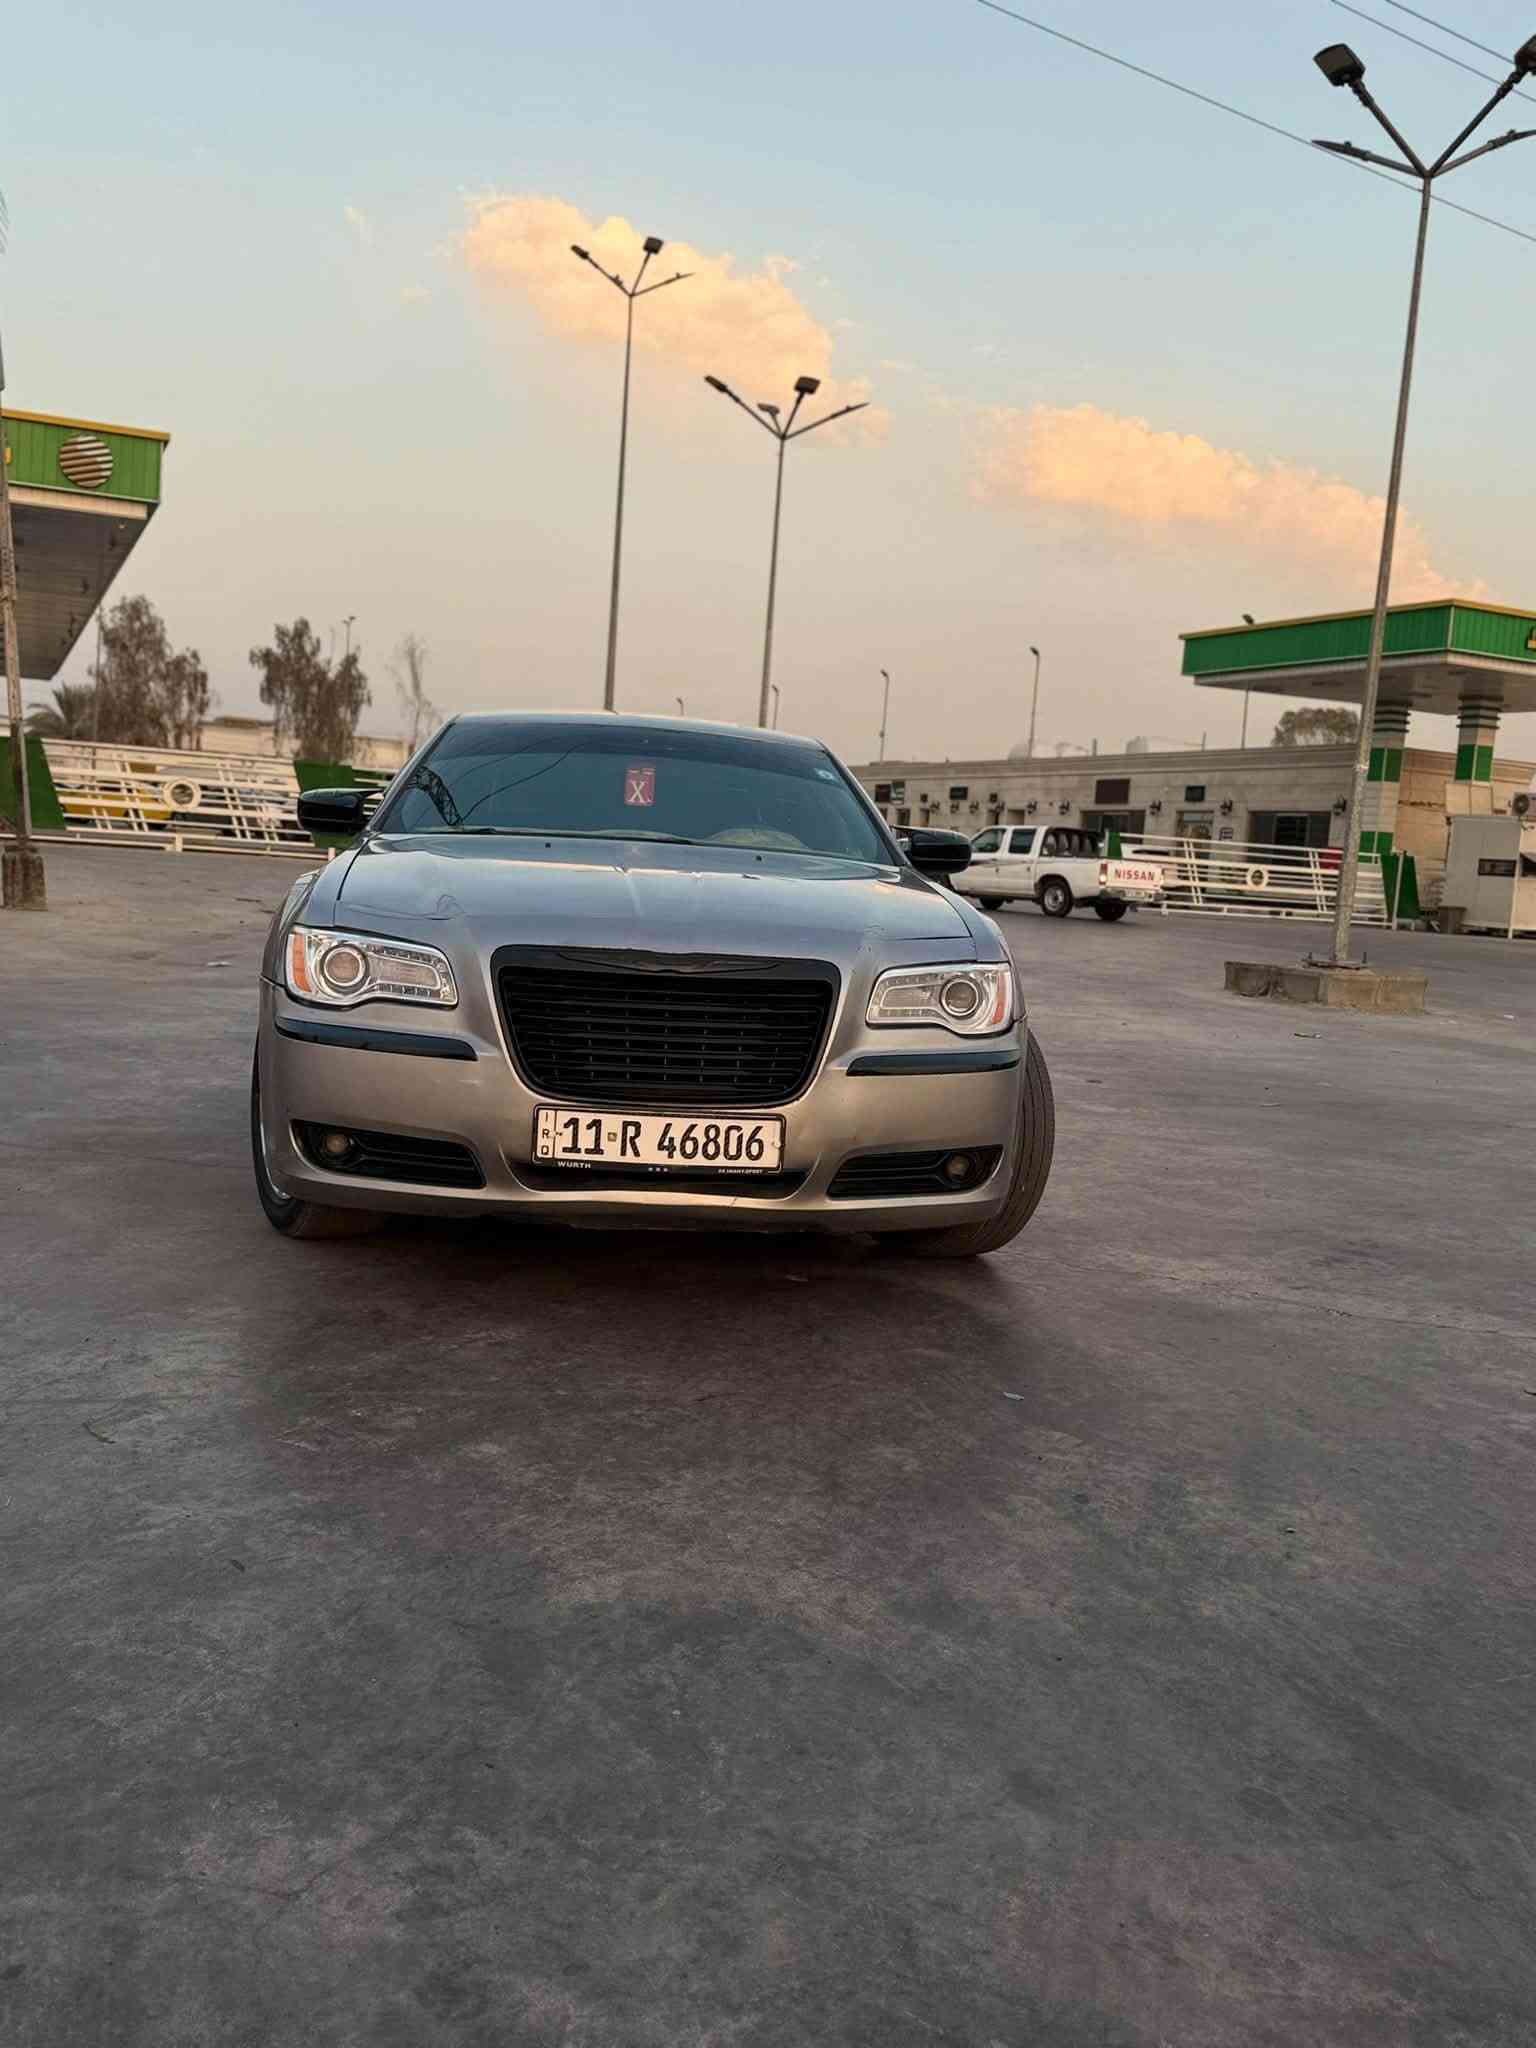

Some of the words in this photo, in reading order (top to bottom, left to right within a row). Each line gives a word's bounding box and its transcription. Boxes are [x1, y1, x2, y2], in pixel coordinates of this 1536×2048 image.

[1115, 869, 1155, 881] NISSAN
[562, 1117, 604, 1155] 11
[620, 1120, 641, 1157] R
[657, 1122, 765, 1161] 46806
